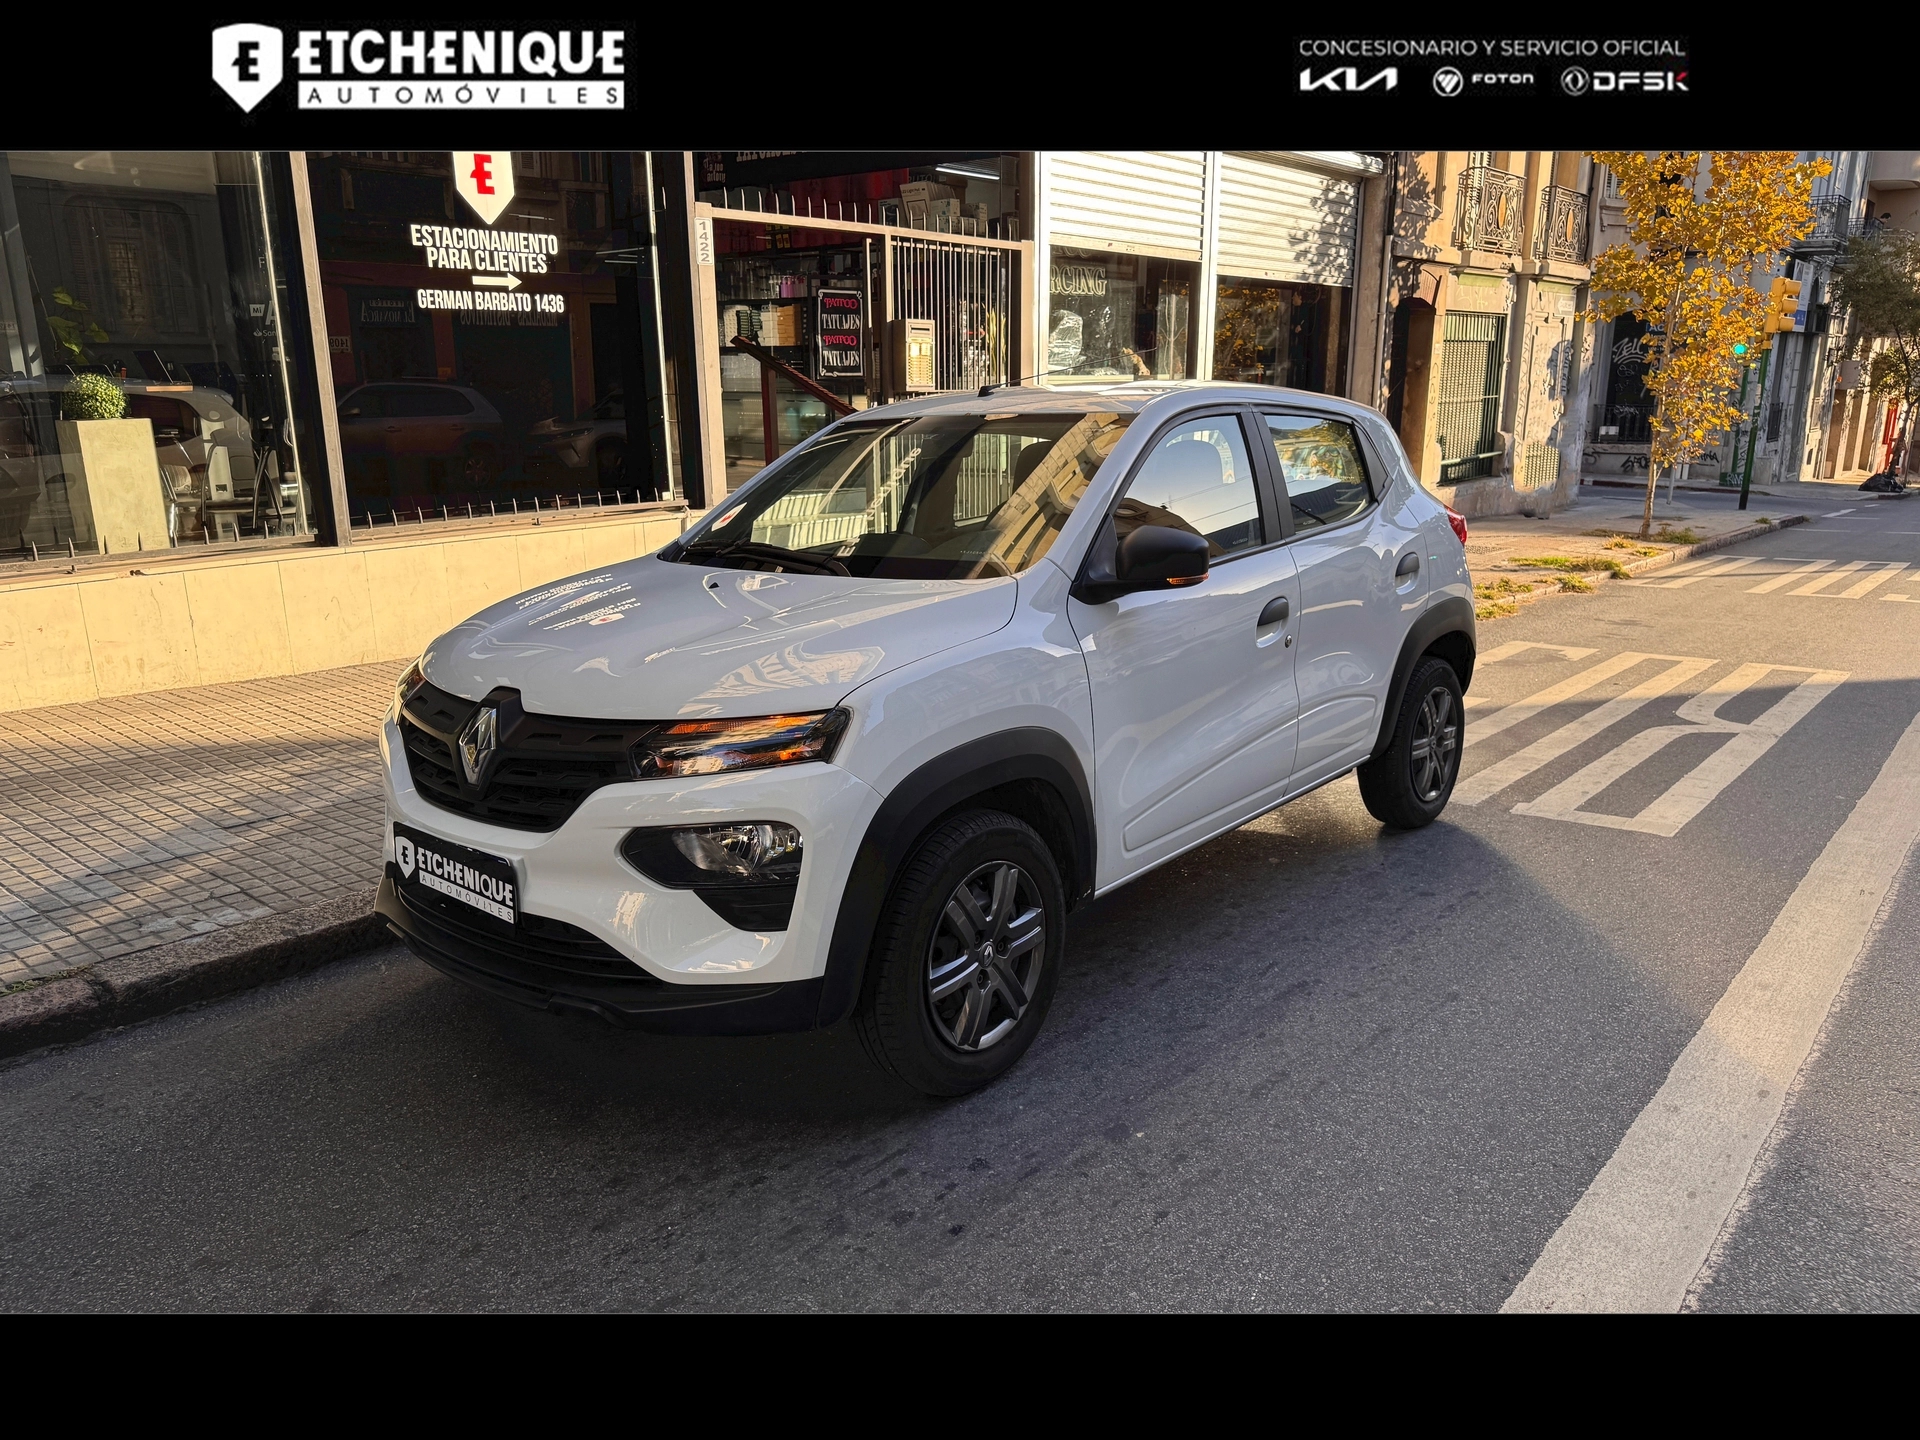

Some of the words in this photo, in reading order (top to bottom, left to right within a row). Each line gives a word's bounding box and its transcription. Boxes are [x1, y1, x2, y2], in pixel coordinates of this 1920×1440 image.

[410, 223, 559, 256] ESTACIONAMIENTO
[698, 220, 711, 263] 1422
[426, 246, 473, 270] PARA
[474, 249, 548, 274] CLIENTES
[417, 288, 473, 310] GERMAN
[474, 291, 532, 312] BARBATO
[534, 293, 565, 313] 1436
[823, 298, 859, 310] TATTOO
[821, 313, 861, 330] TATUAJES
[822, 334, 858, 347] TATTOO
[822, 350, 860, 367] TATUAJES
[417, 846, 514, 908] ETCHENIQUE
[421, 874, 513, 921] AUTOMÓVILES
